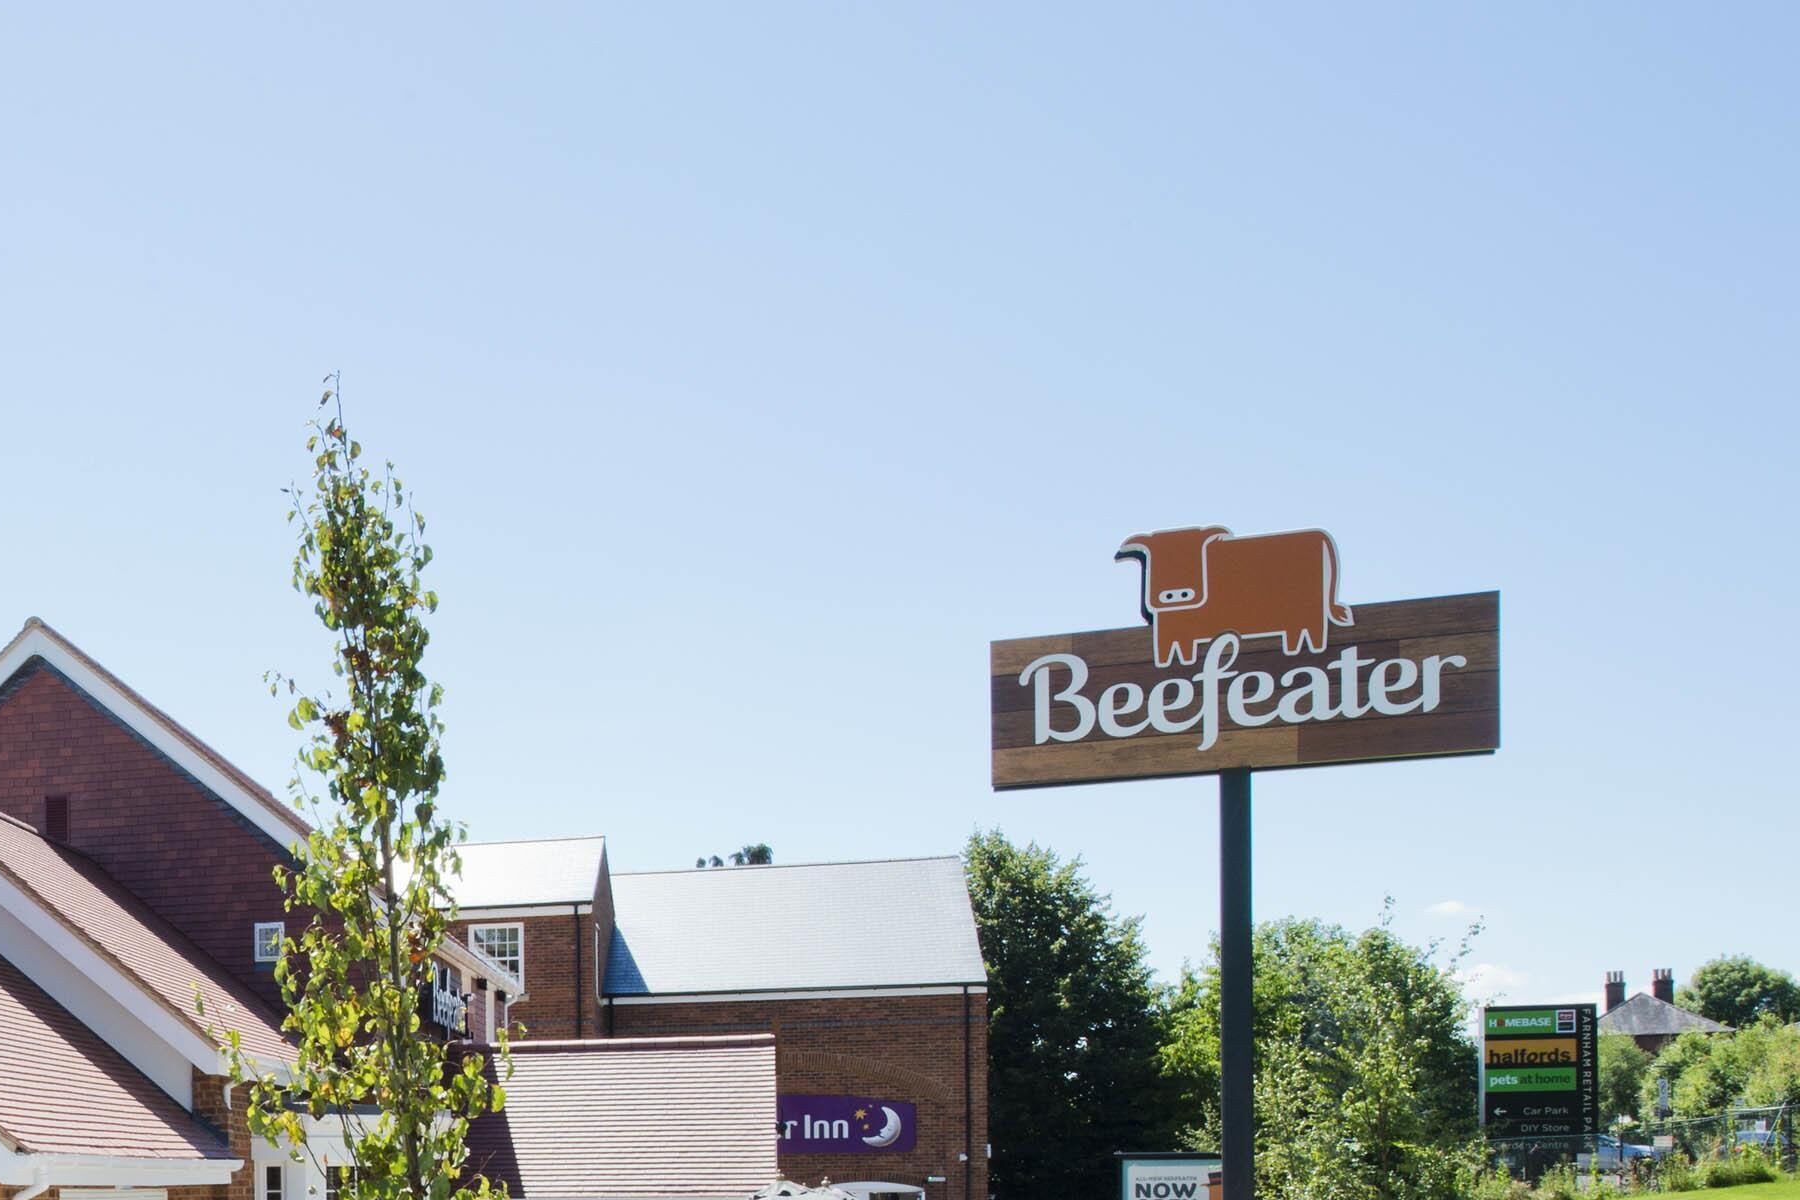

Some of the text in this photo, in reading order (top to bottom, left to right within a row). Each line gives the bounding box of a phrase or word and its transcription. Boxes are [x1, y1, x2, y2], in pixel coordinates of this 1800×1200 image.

[1019, 634, 1467, 751] Beefeater
[1488, 1017, 1552, 1028] HOMEBASE
[1489, 1048, 1571, 1064] halfords
[1489, 1073, 1570, 1087] pets at home
[1582, 1008, 1592, 1149] FARNHAM RETAIL PARK
[1523, 1106, 1569, 1116] Car Park
[804, 1114, 849, 1139] Inn
[1521, 1123, 1570, 1132] DIY Store
[1135, 1182, 1197, 1198] NOW
